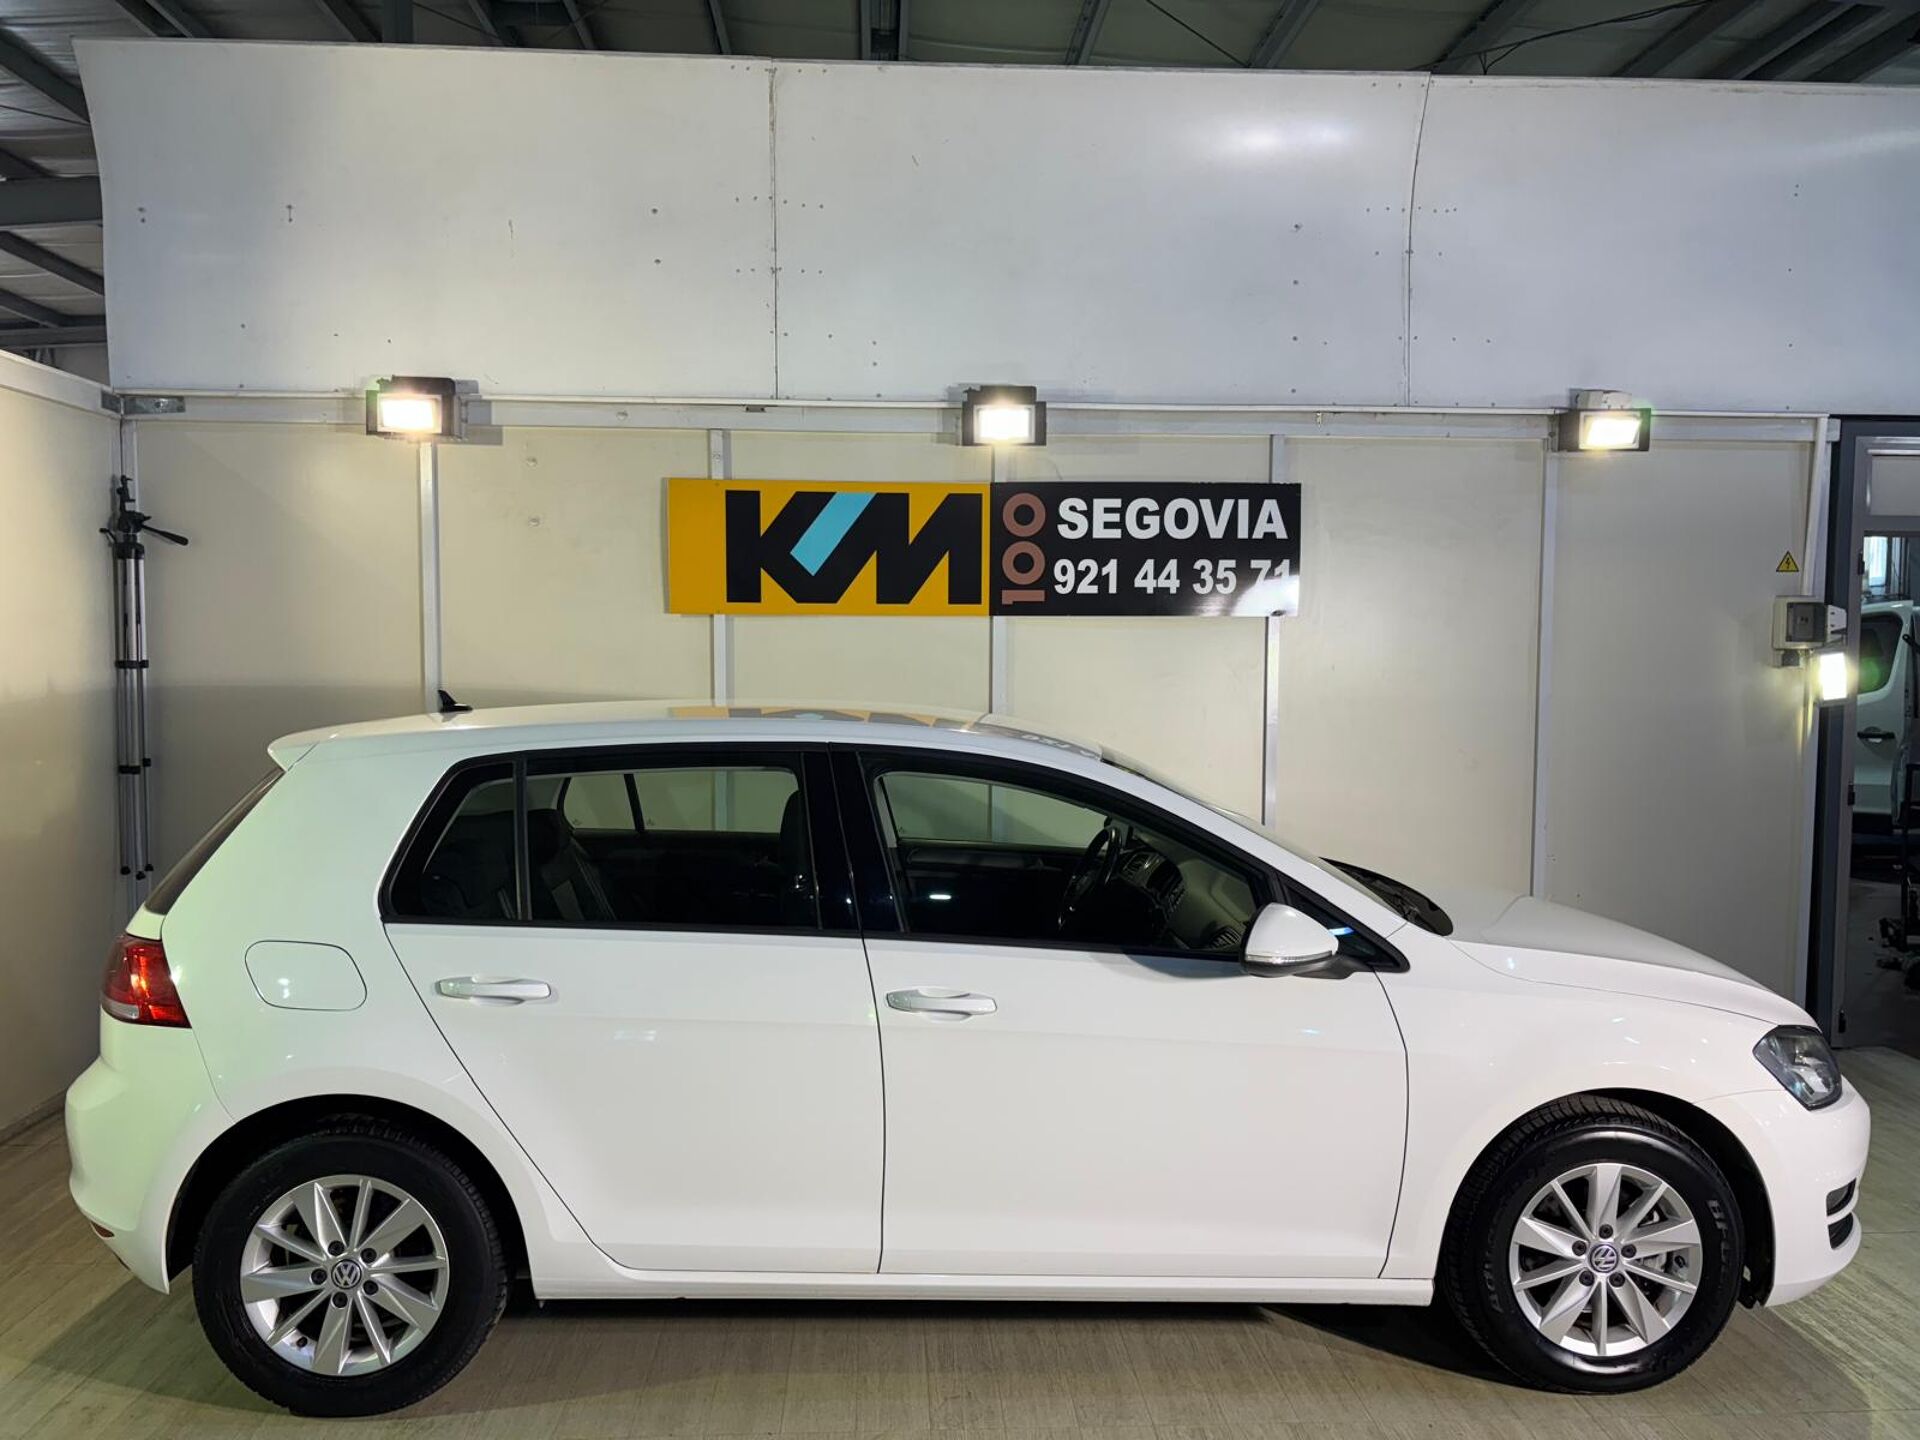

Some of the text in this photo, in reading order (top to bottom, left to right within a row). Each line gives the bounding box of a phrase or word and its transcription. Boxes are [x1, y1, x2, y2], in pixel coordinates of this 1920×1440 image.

[725, 490, 983, 605] KM
[1002, 492, 1046, 605] 100
[1057, 497, 1288, 540] SEGOVIA
[1053, 558, 1118, 595] 921
[1134, 558, 1179, 594] 44
[1192, 558, 1237, 595] 35
